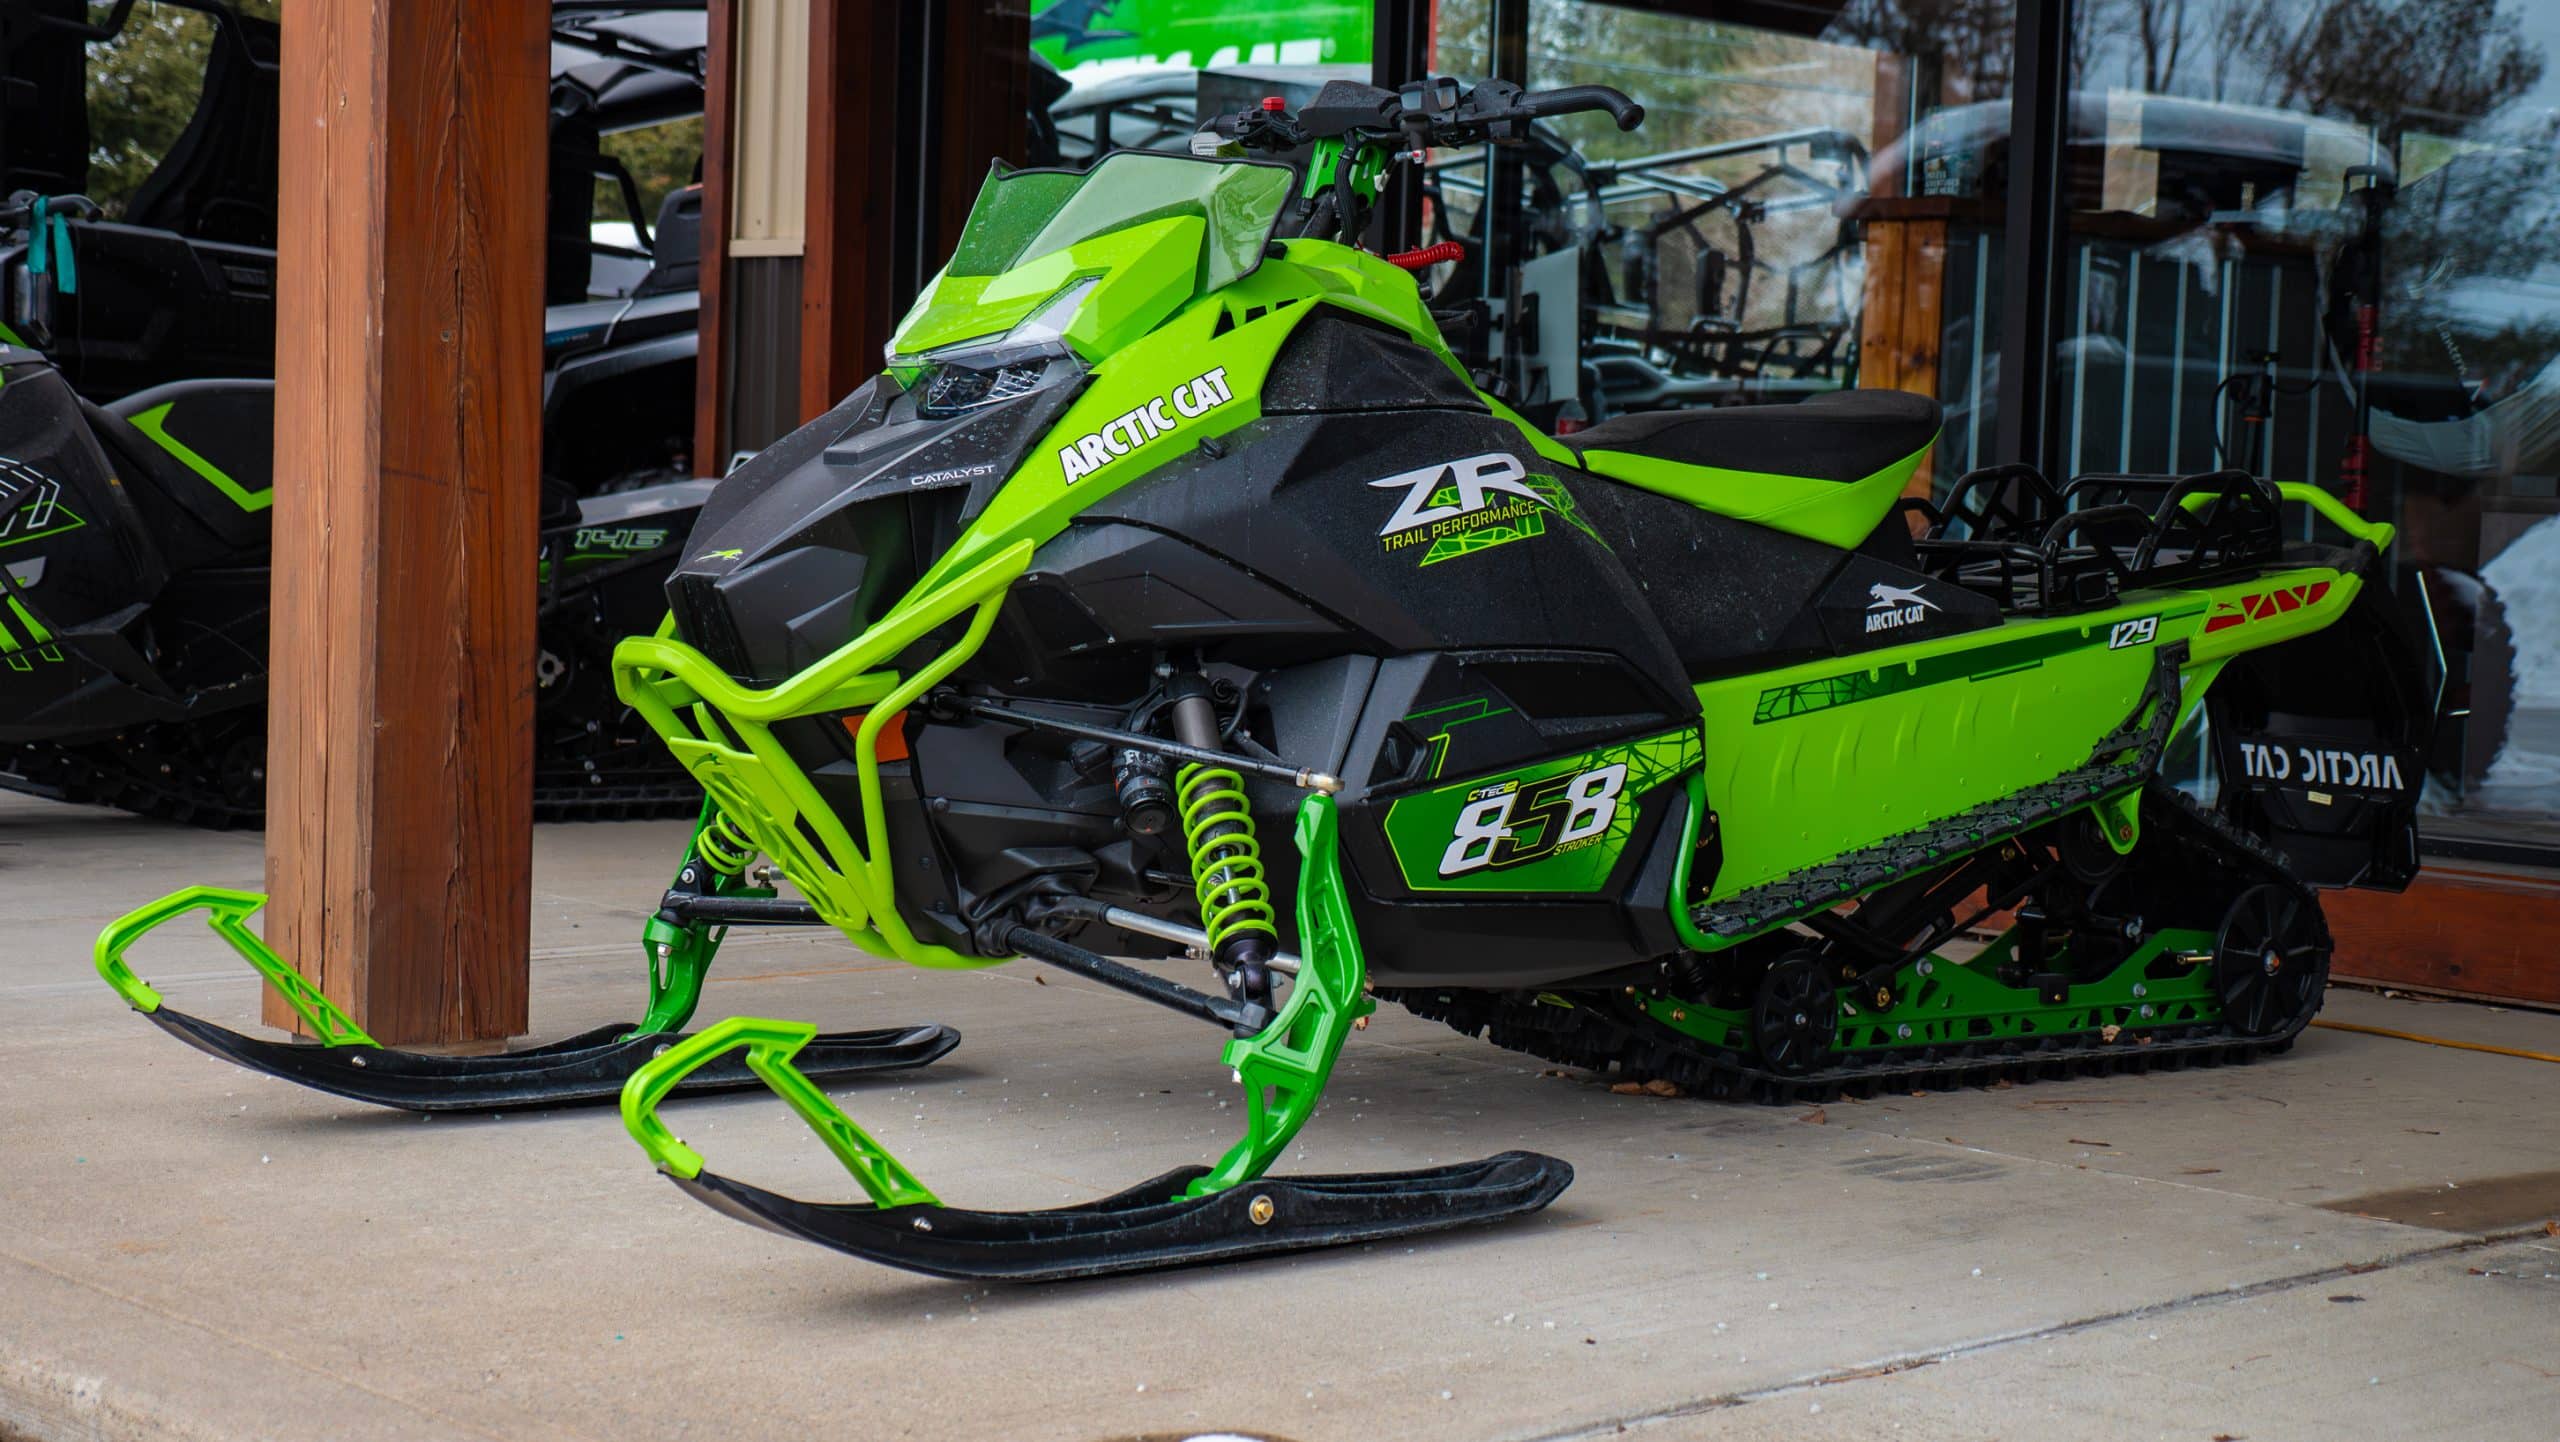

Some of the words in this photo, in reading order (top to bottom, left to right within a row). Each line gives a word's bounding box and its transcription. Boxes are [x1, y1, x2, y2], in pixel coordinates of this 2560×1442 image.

[1058, 398, 1177, 486] ARCTIC
[1171, 366, 1233, 418] CAT
[911, 464, 996, 486] CATALYST
[1367, 453, 1555, 536] ZR
[575, 528, 669, 550] 146
[1383, 528, 1429, 552] TRAIL
[1432, 500, 1537, 539] PERFORMANCE
[1865, 607, 1904, 633] ARCTIC
[1904, 605, 1925, 624] CAT
[2109, 616, 2158, 649] 129
[1438, 763, 1628, 877] 858
[1553, 834, 1604, 856] STROKER
